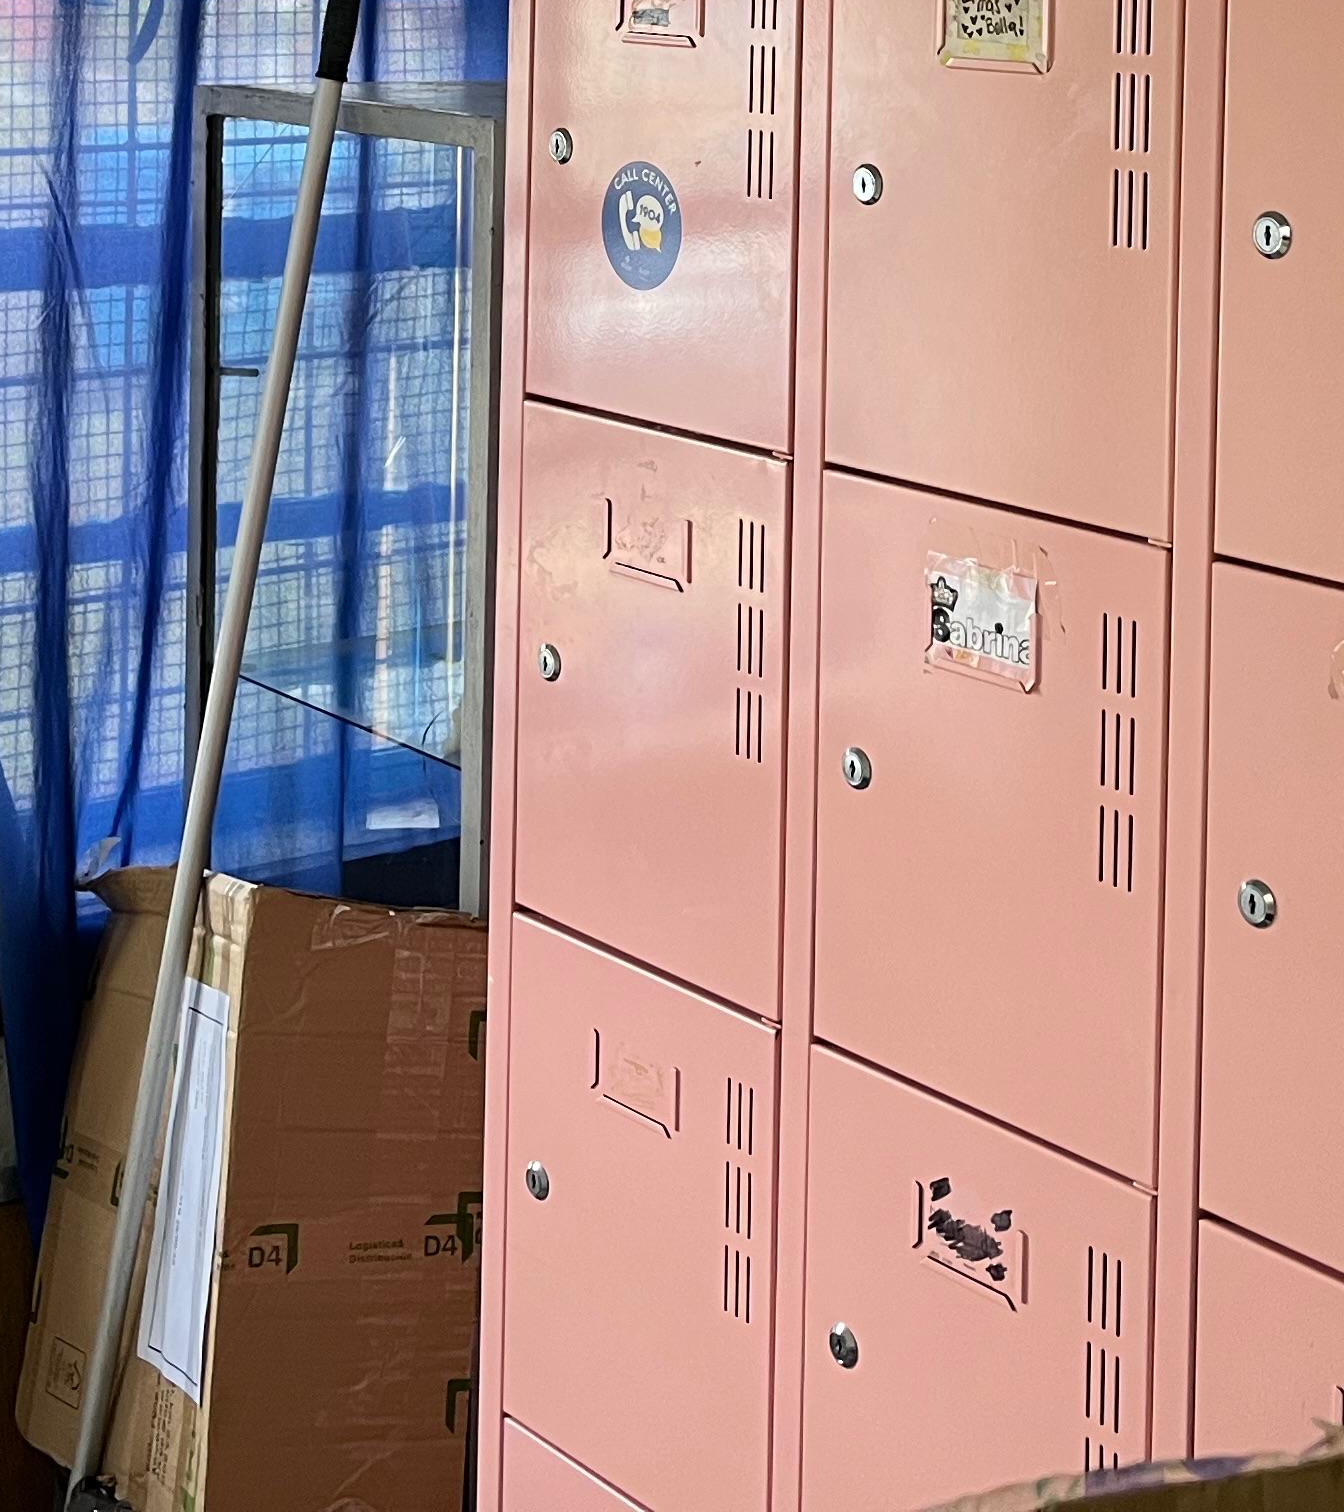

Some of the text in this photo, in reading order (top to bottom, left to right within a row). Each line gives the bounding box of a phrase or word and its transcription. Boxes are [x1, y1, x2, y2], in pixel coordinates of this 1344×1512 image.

[614, 168, 677, 216] CALL CENTER
[639, 204, 661, 225] 1904
[248, 1245, 283, 1268] D4
[423, 1234, 458, 1257] D4
